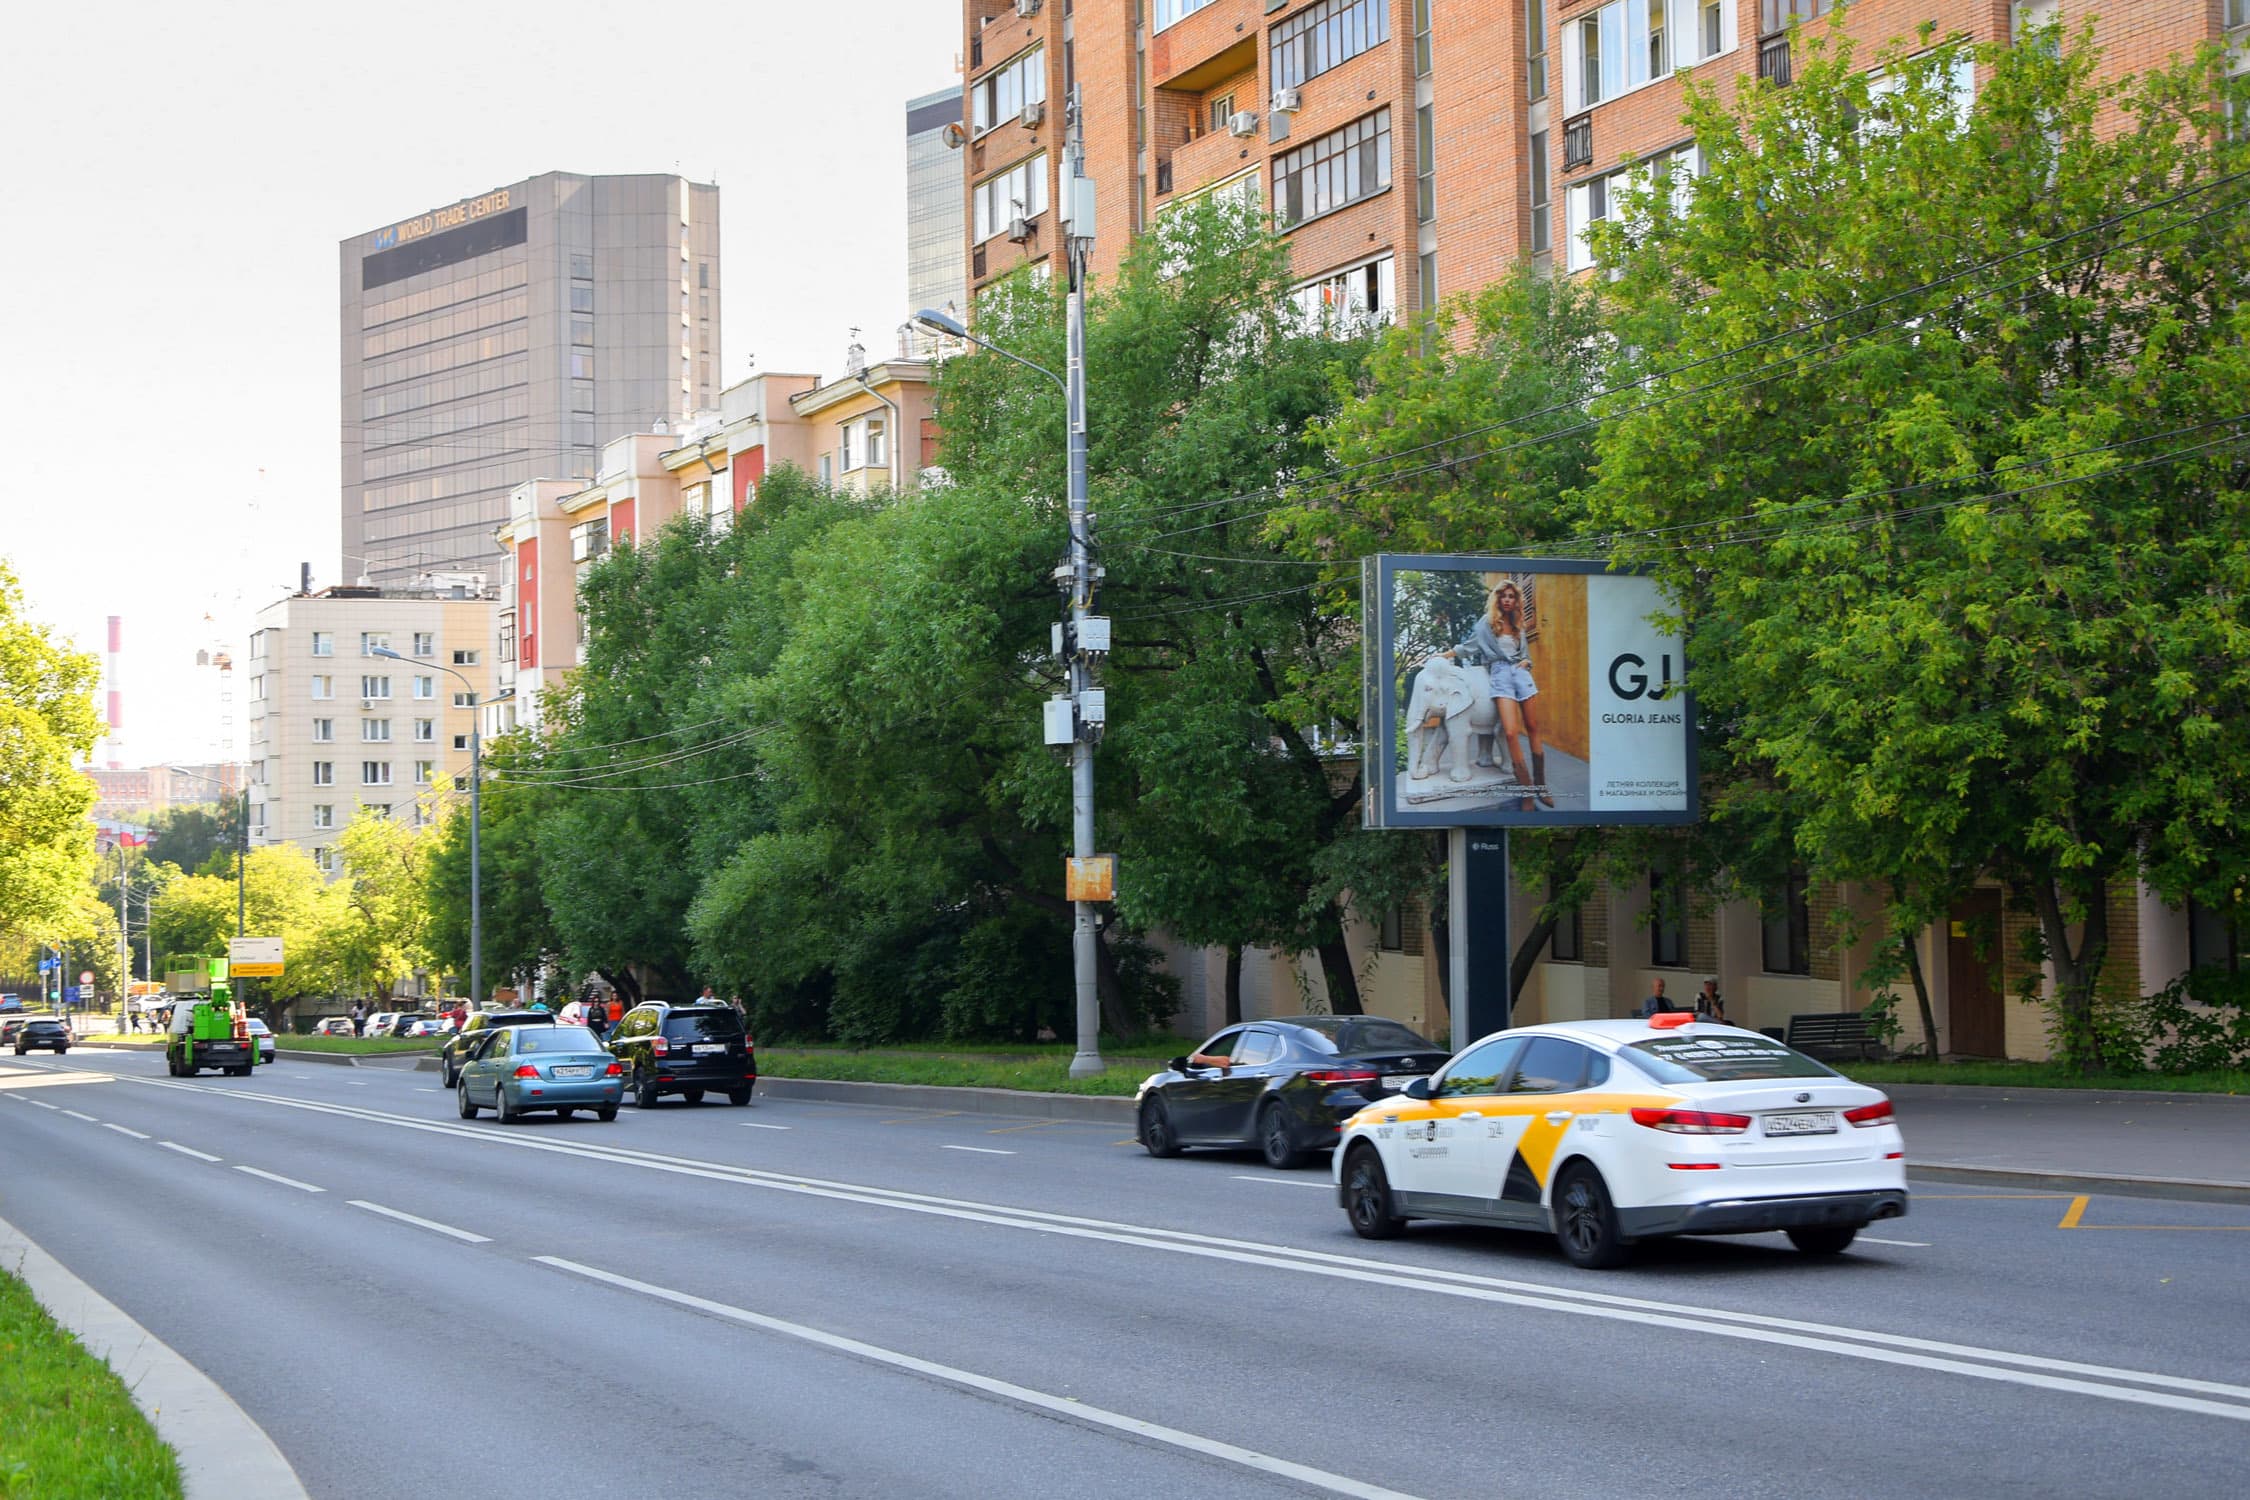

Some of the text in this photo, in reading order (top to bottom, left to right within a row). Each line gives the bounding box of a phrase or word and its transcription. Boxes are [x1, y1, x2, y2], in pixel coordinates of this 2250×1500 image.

[397, 190, 509, 241] WORLD TRADE CENTER
[1609, 653, 1671, 701] GJ
[1602, 713, 1682, 724] GLORIA JEANS
